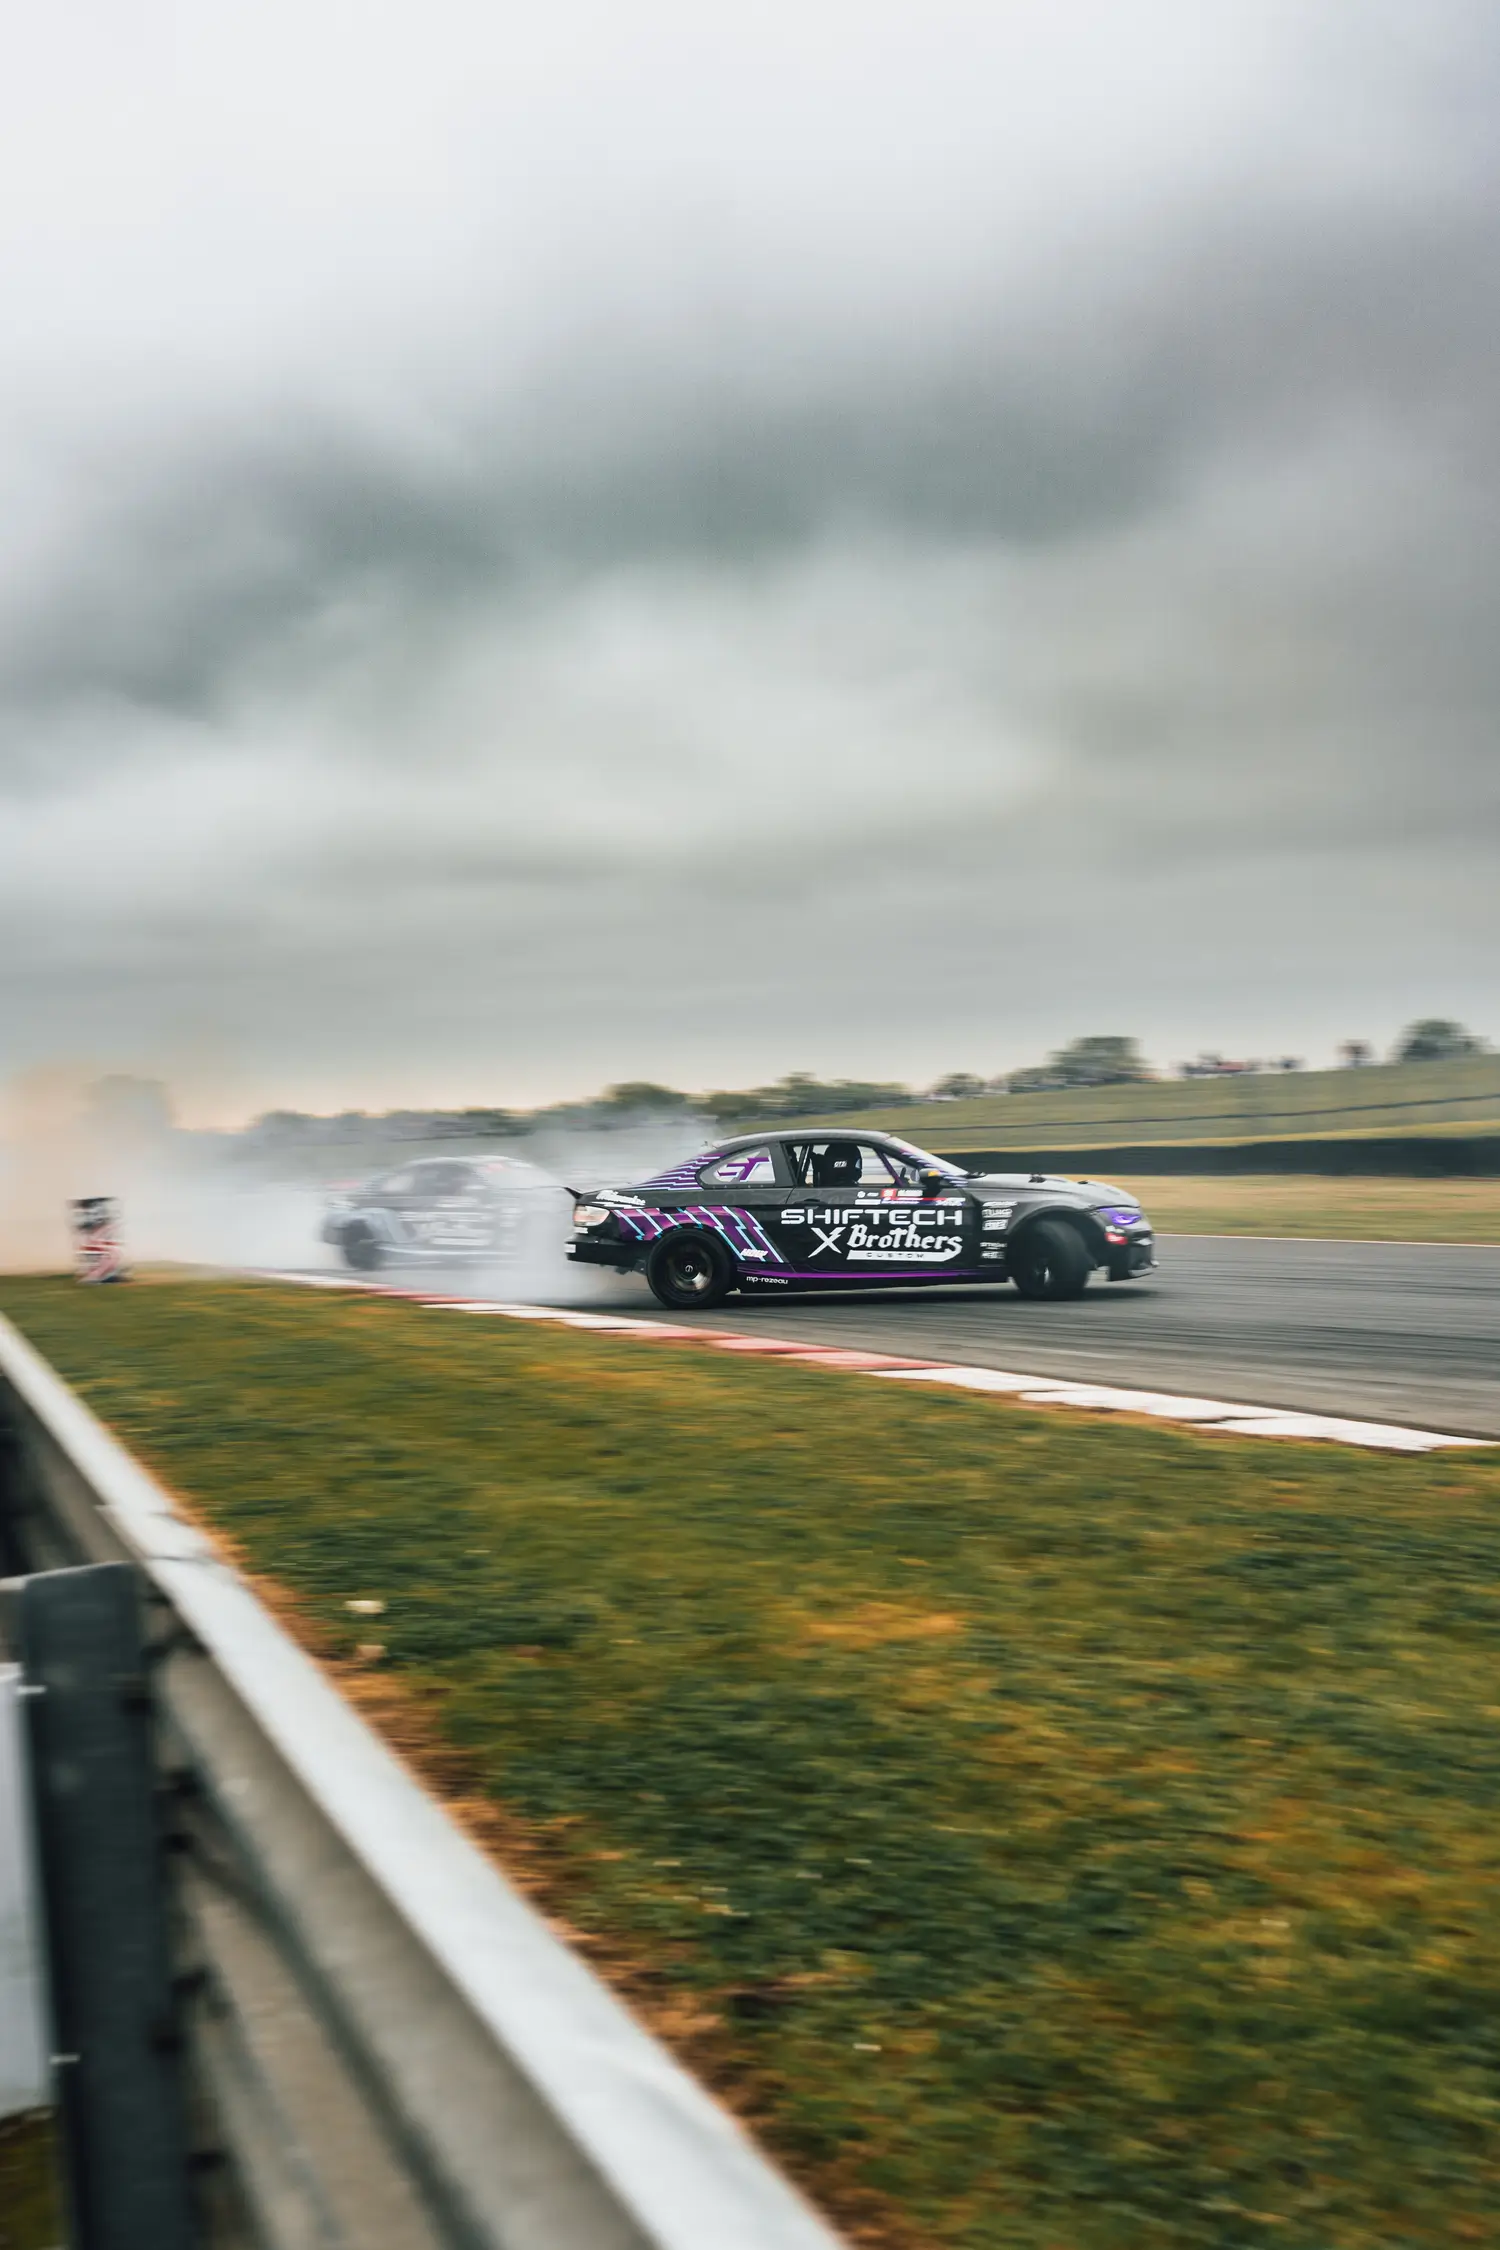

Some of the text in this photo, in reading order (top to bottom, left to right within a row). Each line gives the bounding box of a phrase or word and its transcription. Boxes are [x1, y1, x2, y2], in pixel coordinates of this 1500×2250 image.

[781, 1208, 963, 1226] SHIFTECH
[847, 1224, 963, 1252] Brothers
[746, 1276, 788, 1285] mp-rezeau
